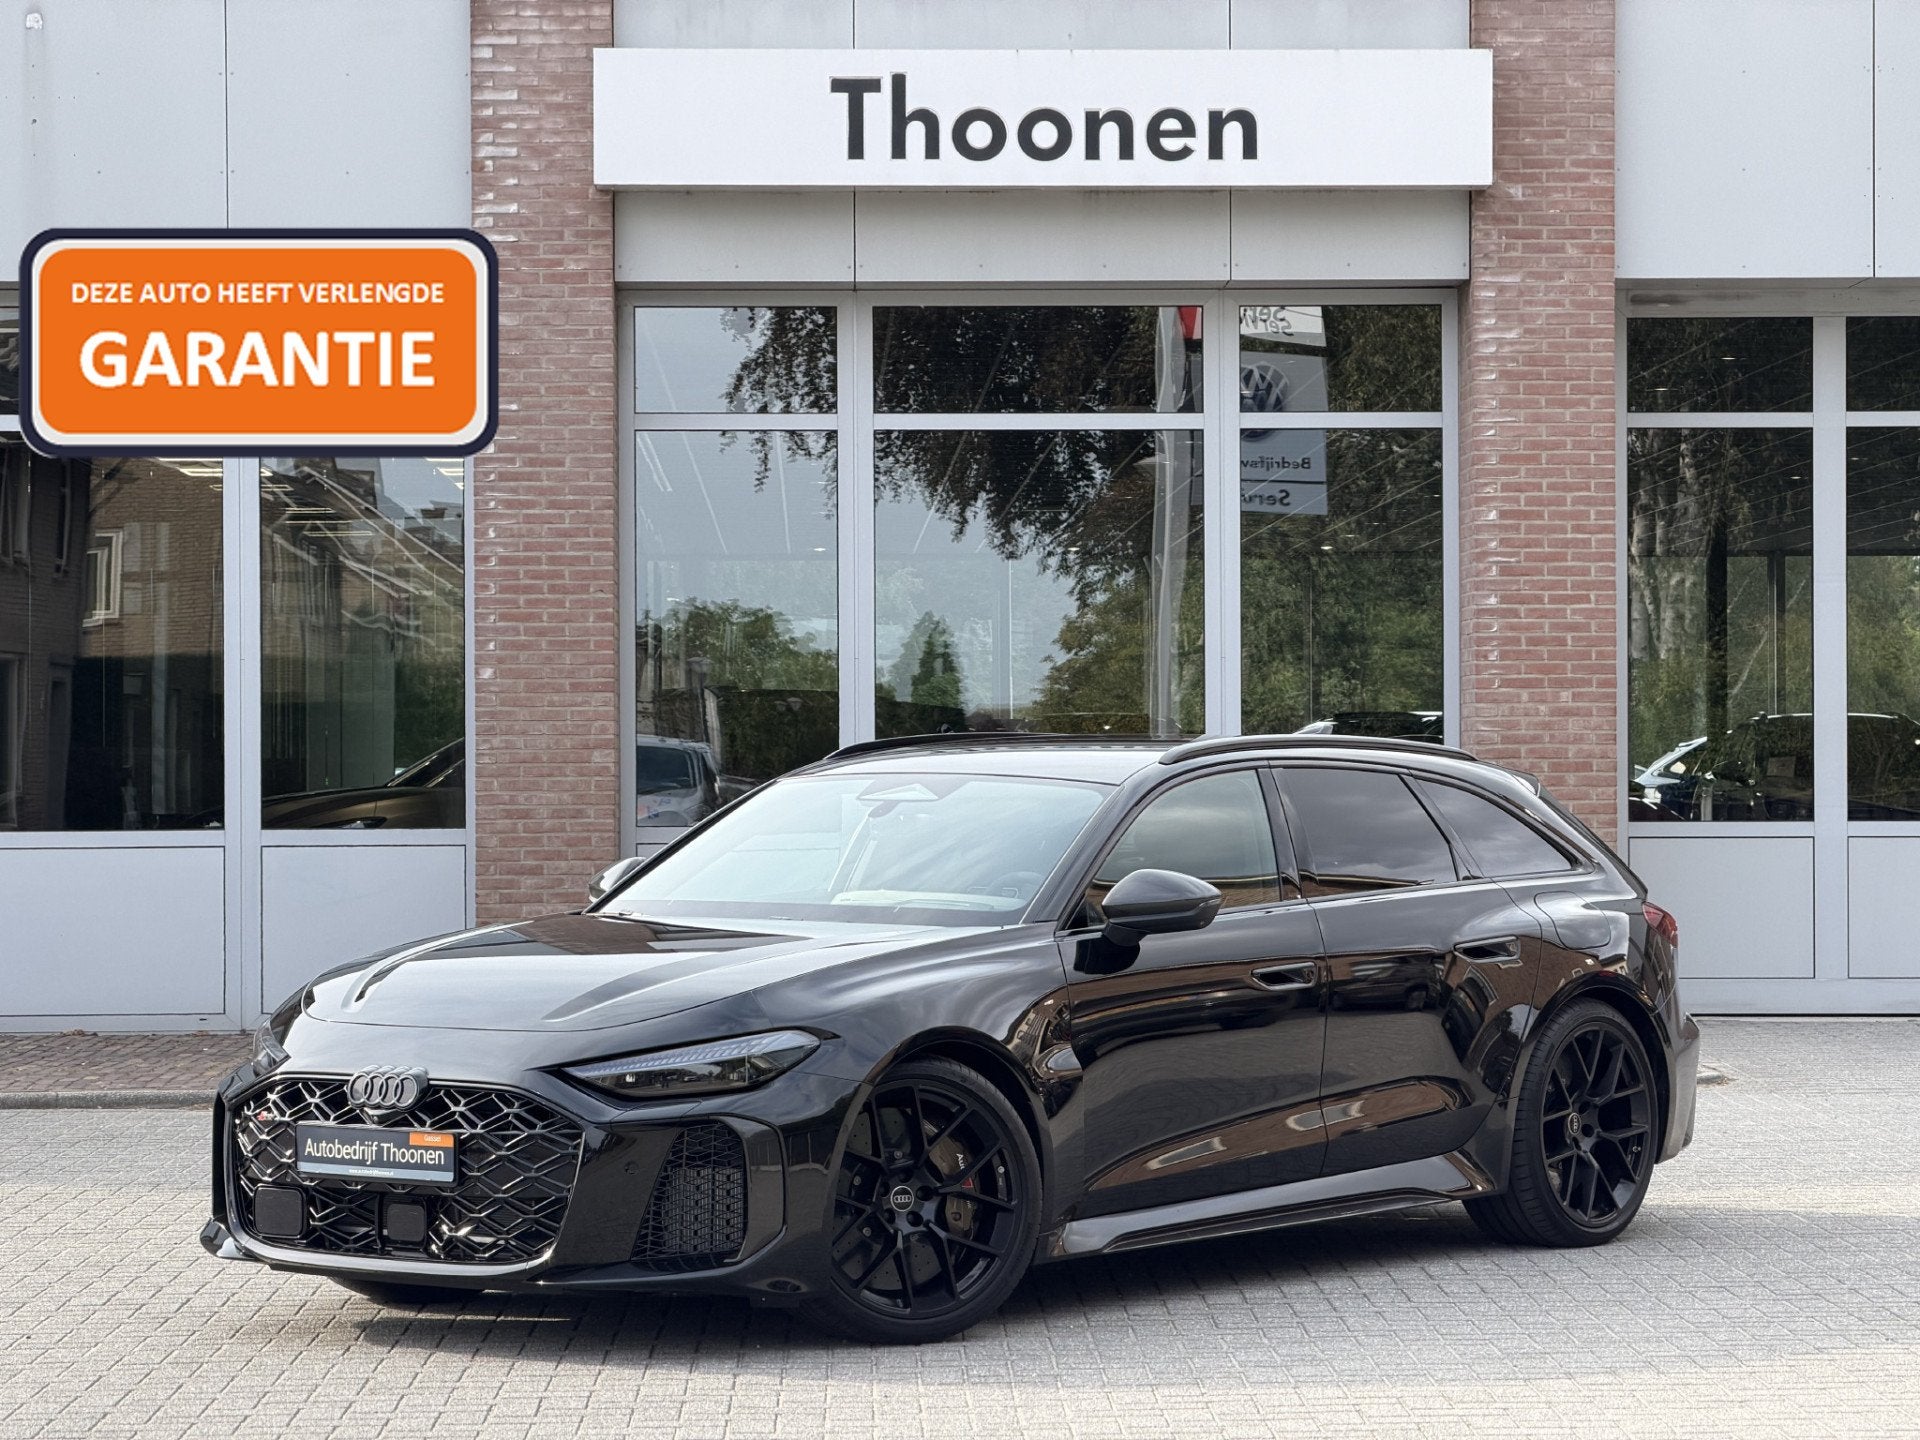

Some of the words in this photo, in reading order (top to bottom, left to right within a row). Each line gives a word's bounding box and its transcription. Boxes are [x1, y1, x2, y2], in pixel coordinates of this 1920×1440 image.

[829, 72, 1258, 162] Thoonen
[304, 1138, 378, 1165] Autobedrijf
[380, 1143, 445, 1165] Thoonen
